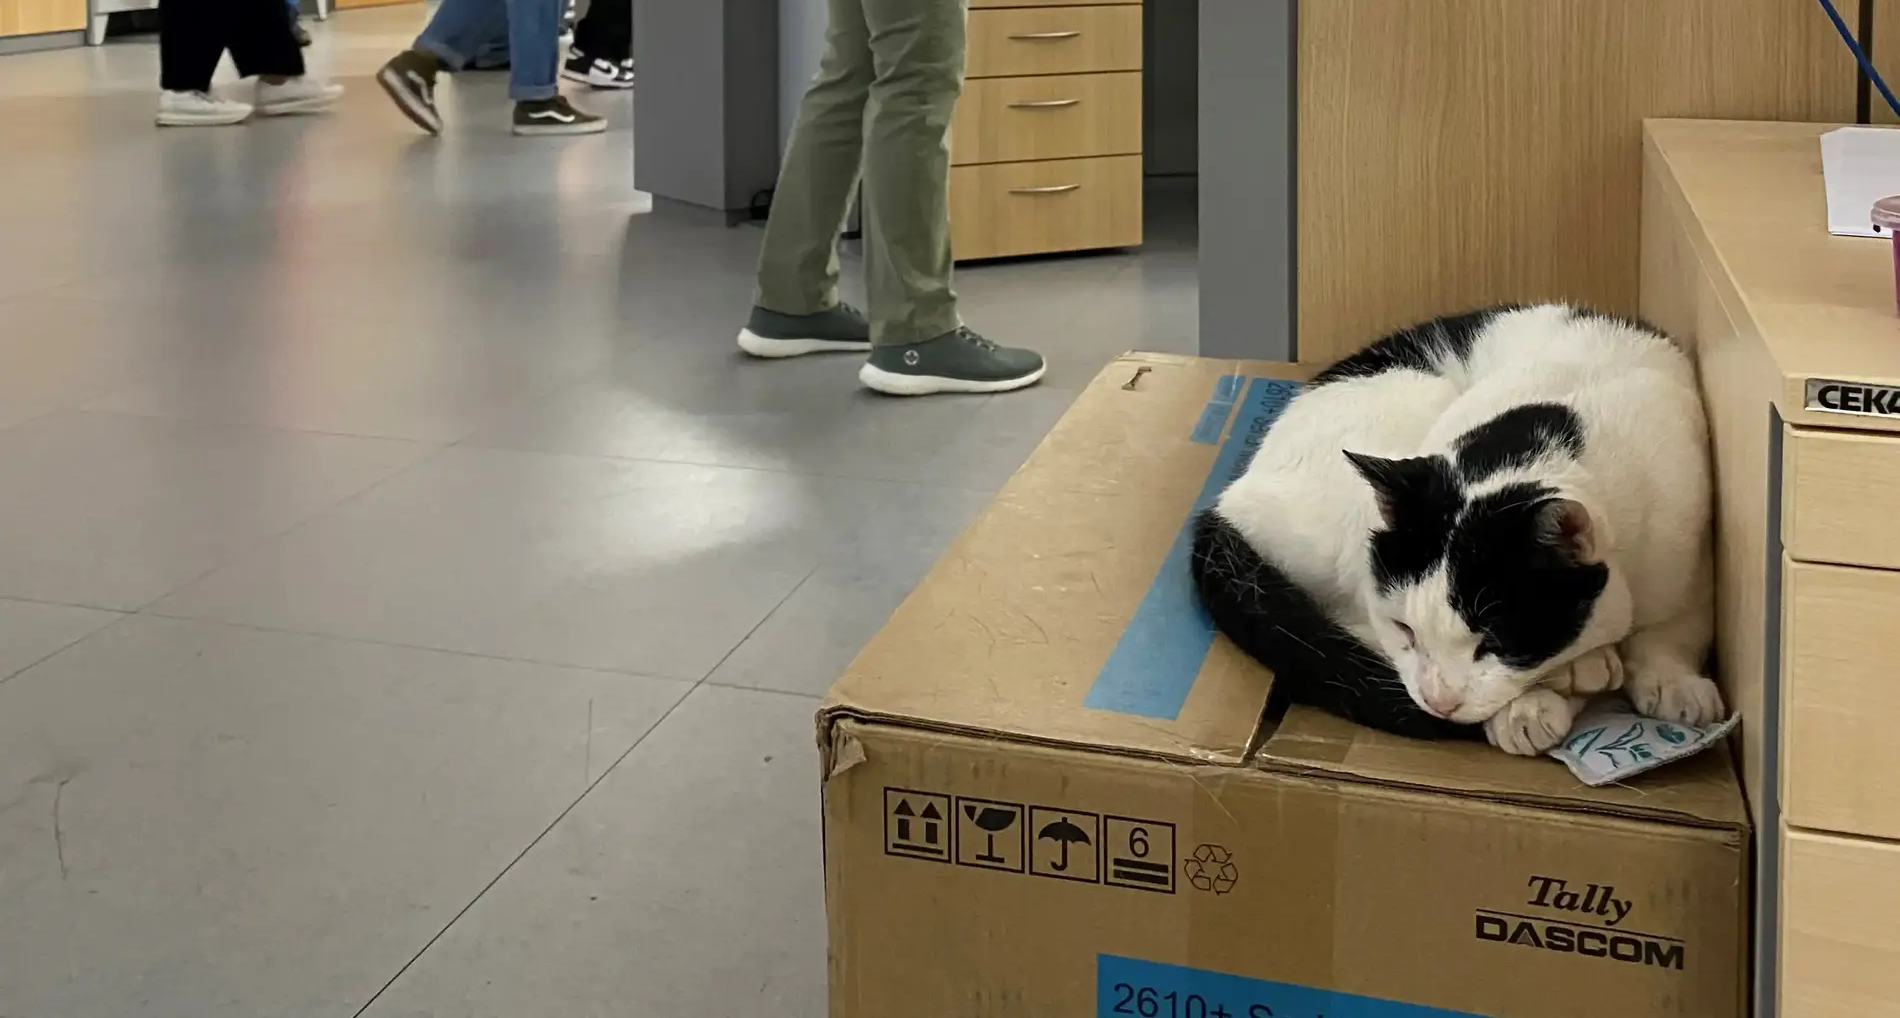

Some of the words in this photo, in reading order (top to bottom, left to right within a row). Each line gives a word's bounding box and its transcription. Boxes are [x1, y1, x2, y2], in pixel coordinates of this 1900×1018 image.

[1129, 827, 1149, 858] 6
[1527, 875, 1632, 925] Tally
[1475, 914, 1685, 970] DASCOM
[1113, 983, 1225, 1018] 2610+
